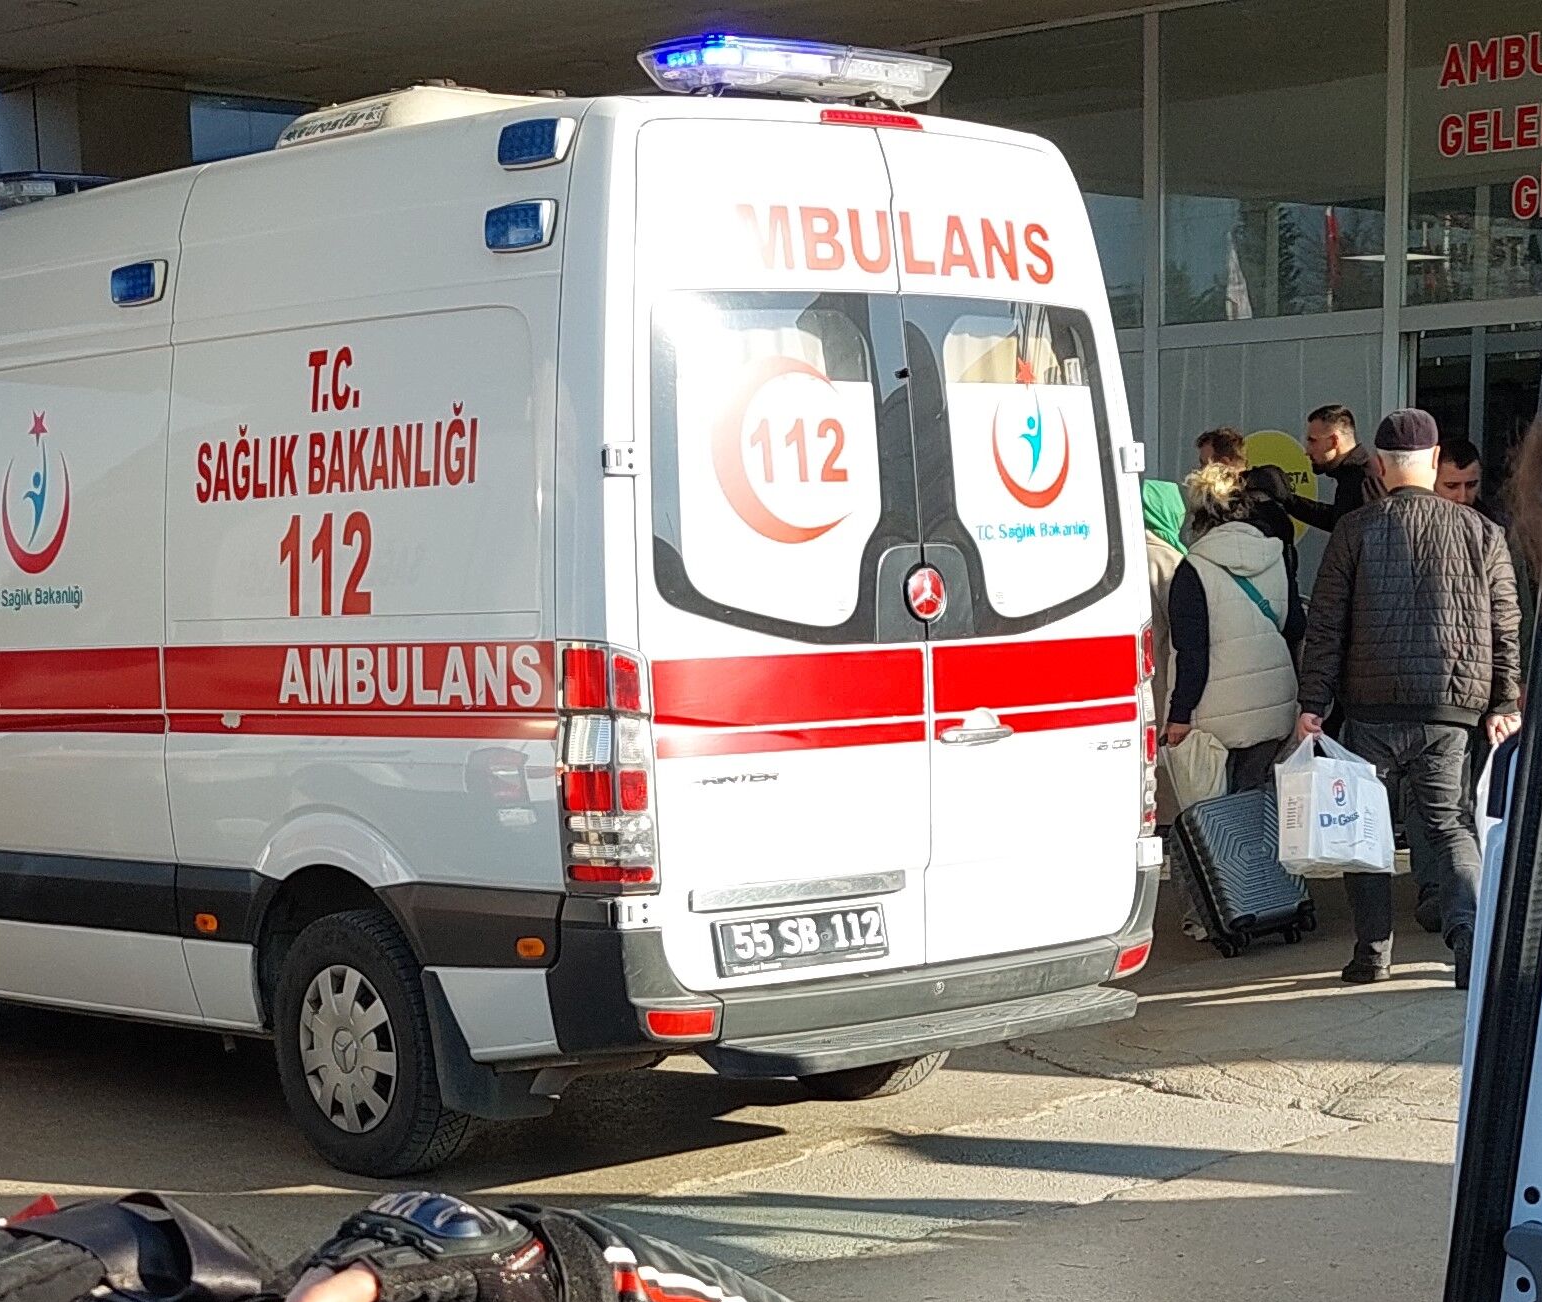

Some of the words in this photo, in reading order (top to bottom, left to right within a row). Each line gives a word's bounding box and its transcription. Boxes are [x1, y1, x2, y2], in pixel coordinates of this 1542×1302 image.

[735, 204, 1056, 286] MBULANS
[309, 346, 360, 413] T.C.
[195, 423, 300, 503] SAĞLIK
[307, 400, 479, 496] BAKANLIĞI
[749, 417, 849, 484] 112
[279, 510, 373, 617] 112
[1, 588, 32, 611] Sağlık
[34, 584, 84, 609] Bakanlığı
[277, 644, 545, 708] AMBULANS
[731, 922, 774, 960] 55
[778, 917, 820, 955] SB
[830, 910, 884, 948] 112
